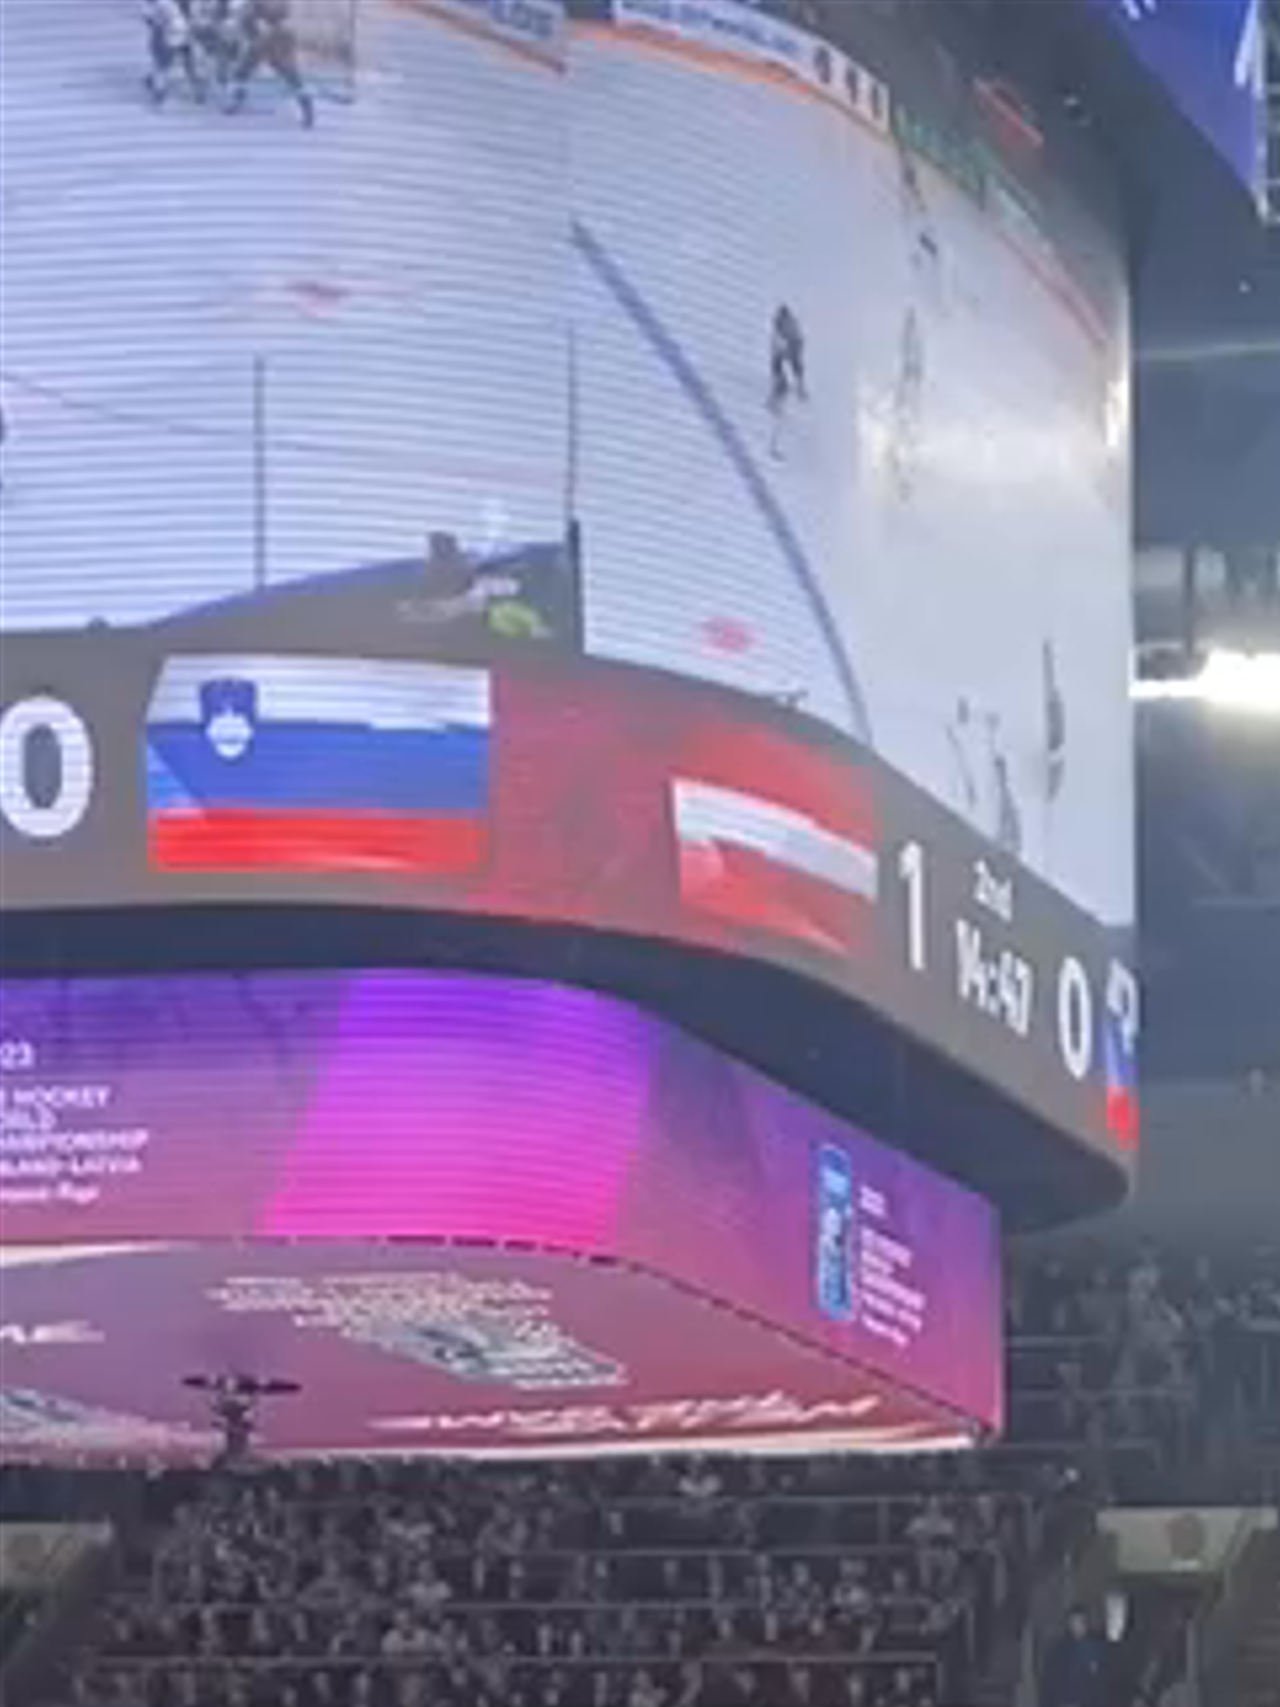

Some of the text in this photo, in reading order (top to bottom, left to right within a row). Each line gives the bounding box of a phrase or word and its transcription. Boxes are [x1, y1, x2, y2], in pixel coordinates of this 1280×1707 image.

[0, 697, 91, 835] 0
[899, 841, 923, 971] 1
[1057, 954, 1092, 1081] 0
